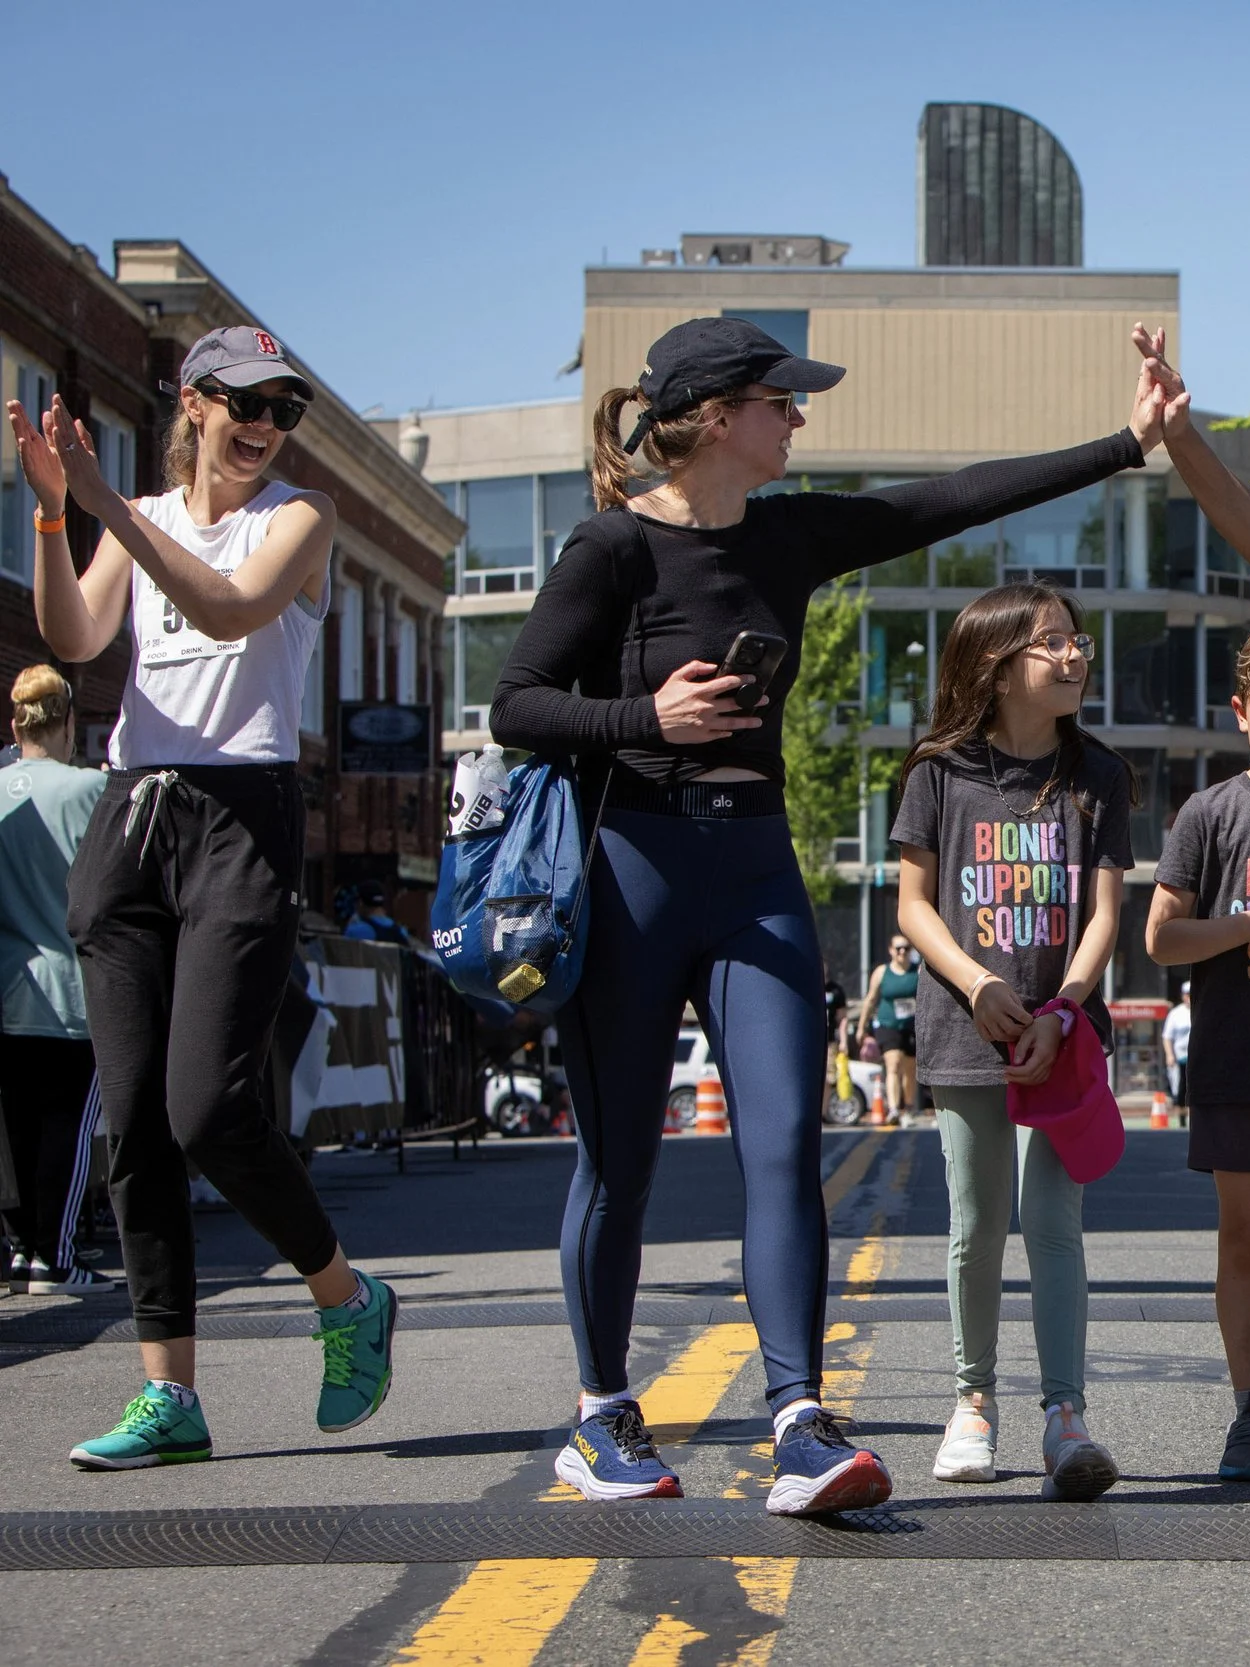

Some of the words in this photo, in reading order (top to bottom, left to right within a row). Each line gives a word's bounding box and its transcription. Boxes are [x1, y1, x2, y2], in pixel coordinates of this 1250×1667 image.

[254, 332, 278, 355] B
[147, 651, 167, 660] FOOD
[181, 646, 203, 656] DRINK
[216, 643, 240, 652] DRINK
[712, 794, 733, 808] alo
[974, 821, 1066, 862] BIONIC
[961, 863, 1082, 907] SUPPORT
[976, 905, 1067, 955] SQUAD
[444, 945, 463, 958] CLINIC
[574, 1430, 599, 1466] HOKA
